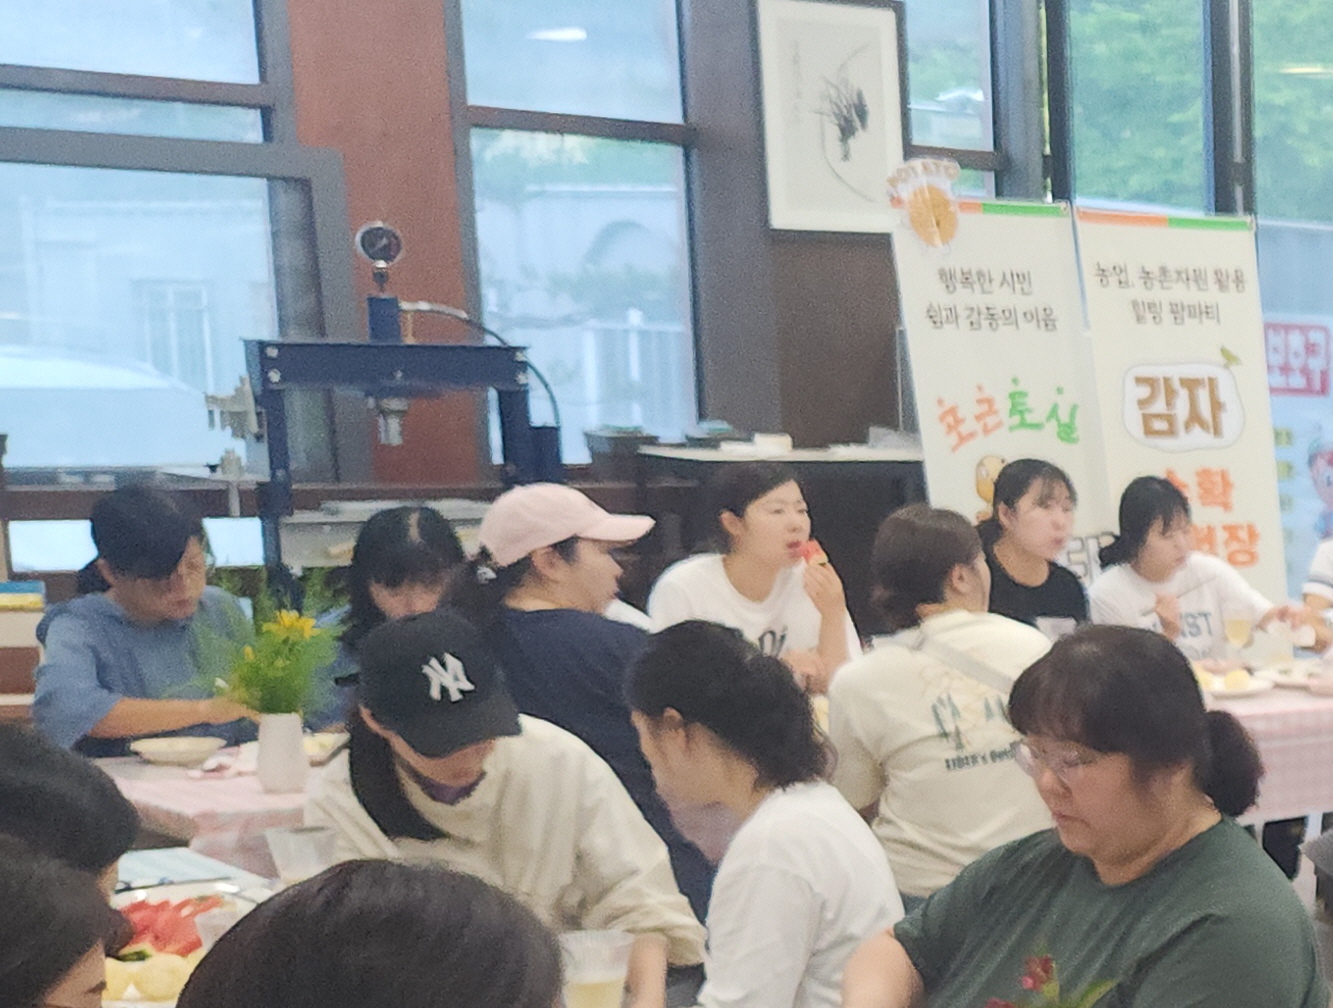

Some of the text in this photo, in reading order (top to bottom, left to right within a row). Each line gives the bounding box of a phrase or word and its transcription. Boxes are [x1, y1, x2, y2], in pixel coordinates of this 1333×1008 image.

[937, 266, 1033, 296] 행복한 시민
[1138, 264, 1209, 292] 농촌자원
[1213, 267, 1246, 294] 활용
[926, 302, 1058, 332] 쉼과 감동의 이음
[1131, 298, 1163, 326] 힐링
[936, 376, 1080, 452] 포근토실
[1134, 375, 1227, 439] 감자
[420, 652, 475, 702] NY
